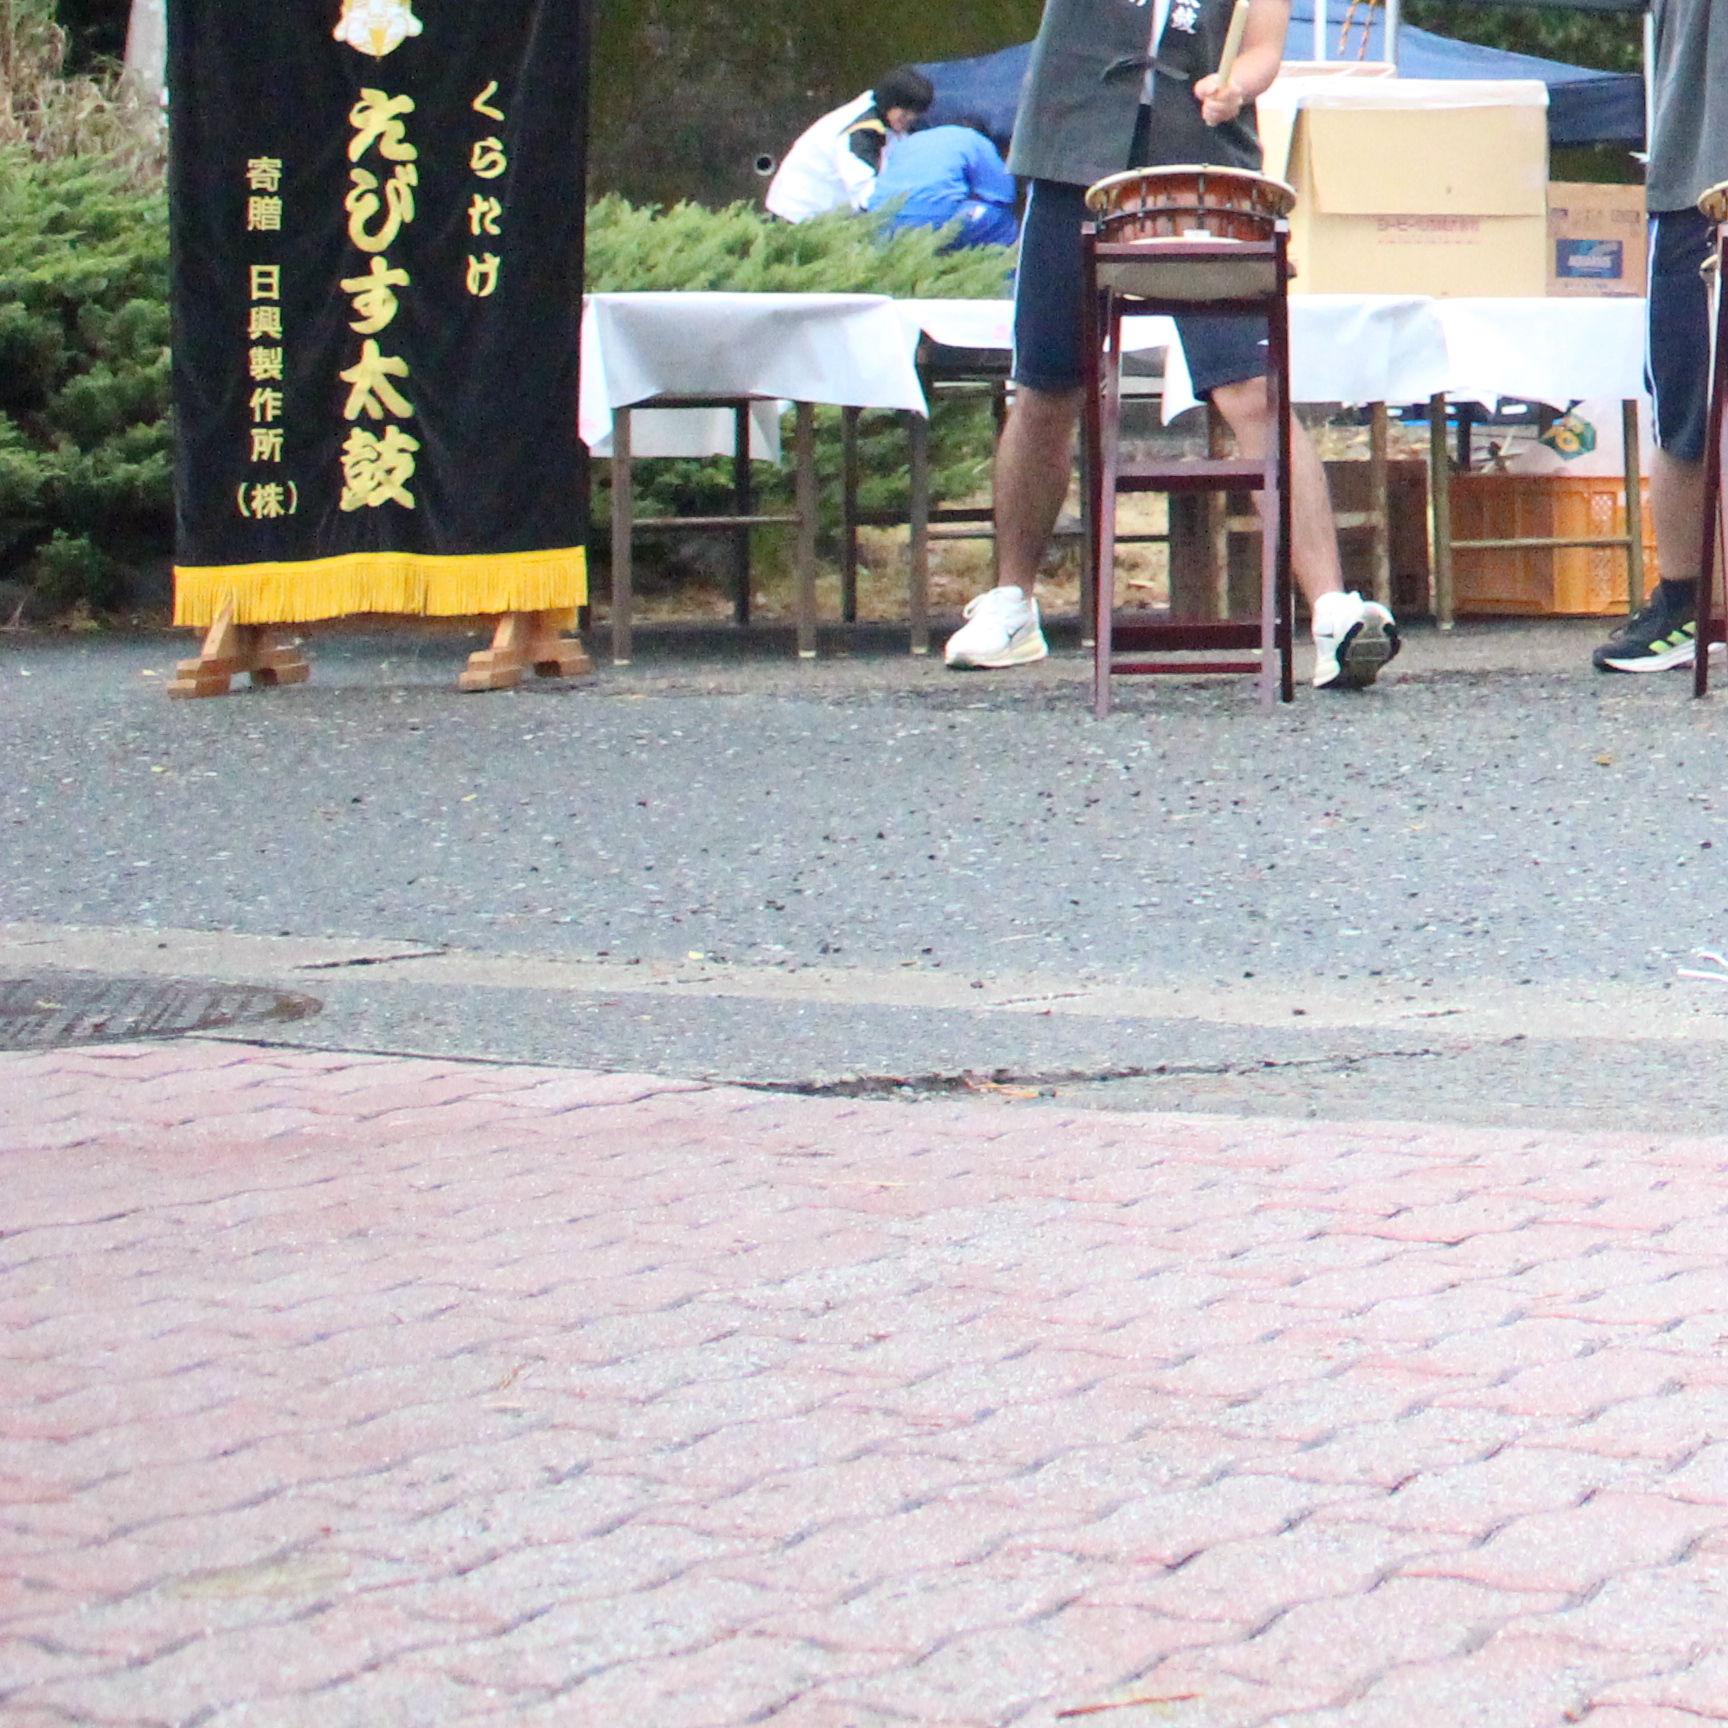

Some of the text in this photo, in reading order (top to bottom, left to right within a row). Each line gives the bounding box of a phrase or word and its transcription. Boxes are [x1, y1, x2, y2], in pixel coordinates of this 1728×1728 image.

[245, 156, 283, 231] 寄贈
[466, 80, 507, 297] くらたけ
[339, 87, 420, 511] えびす太鼓
